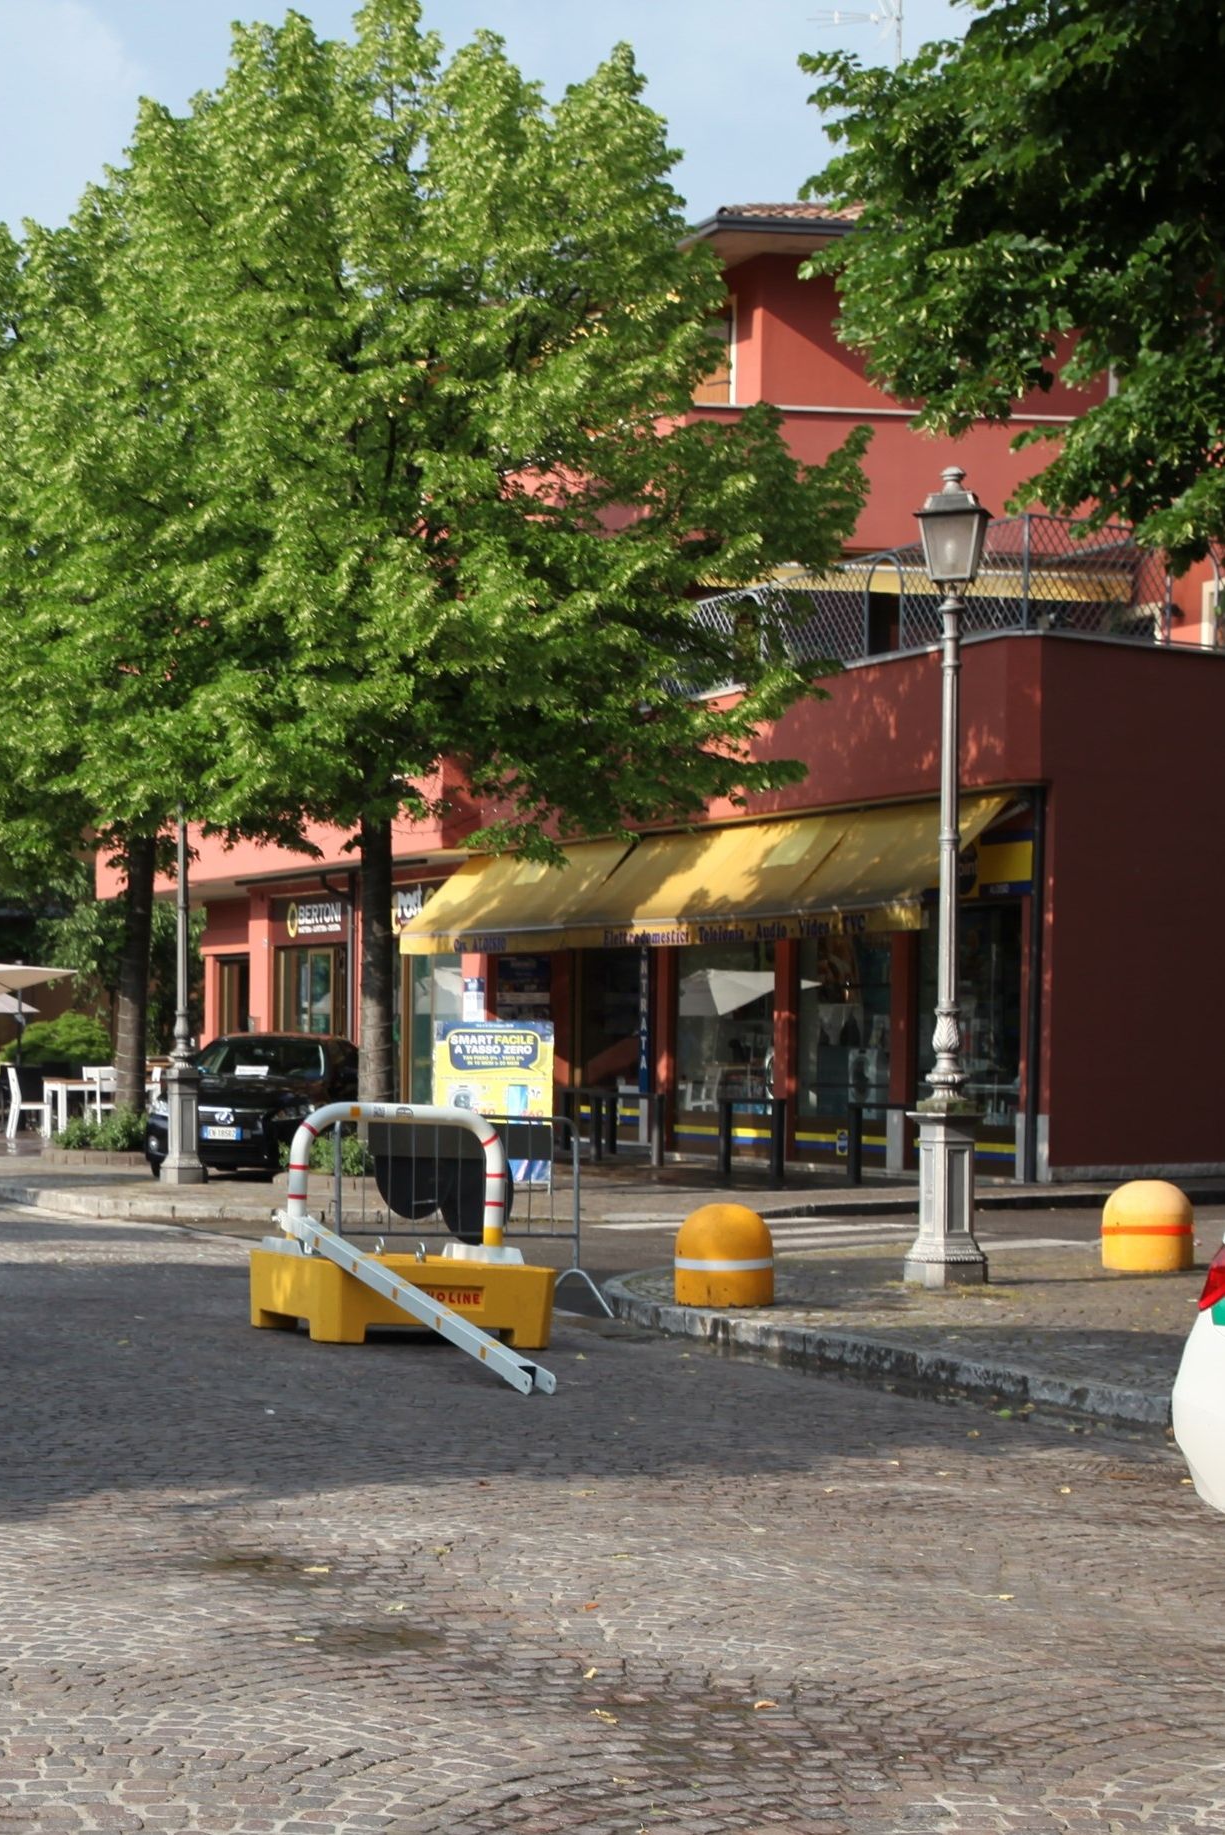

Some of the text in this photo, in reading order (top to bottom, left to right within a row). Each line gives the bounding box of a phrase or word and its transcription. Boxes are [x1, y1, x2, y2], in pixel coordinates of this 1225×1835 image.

[298, 902, 341, 924] BERTONI
[603, 929, 690, 946] Elettrodomestici
[699, 924, 743, 943] Telefonia
[756, 920, 787, 939] Audio
[798, 917, 829, 937] Video
[450, 1034, 534, 1045] SMART FACILE
[454, 1045, 532, 1054] A TASSO ZERO
